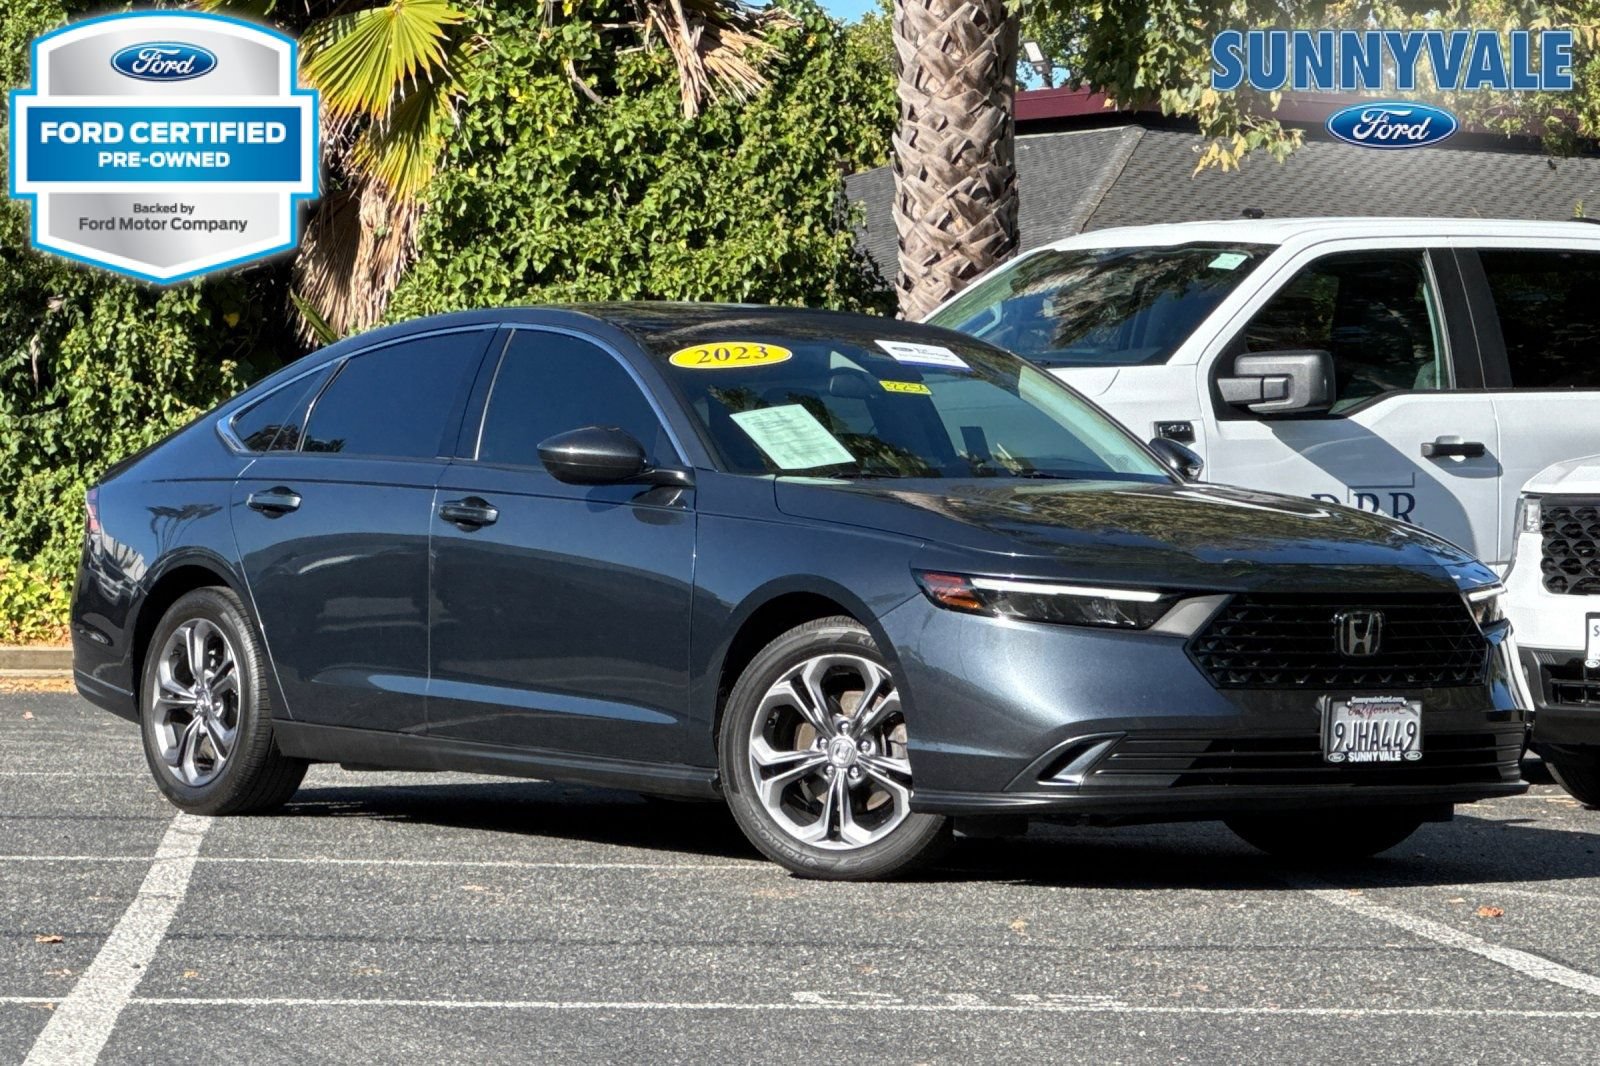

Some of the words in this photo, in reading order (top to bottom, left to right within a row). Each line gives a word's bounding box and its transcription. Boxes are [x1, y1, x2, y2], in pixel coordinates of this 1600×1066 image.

[695, 345, 769, 364] 2023
[1333, 721, 1418, 752] 9JHA449
[1348, 751, 1401, 762] SUNNYVALE
